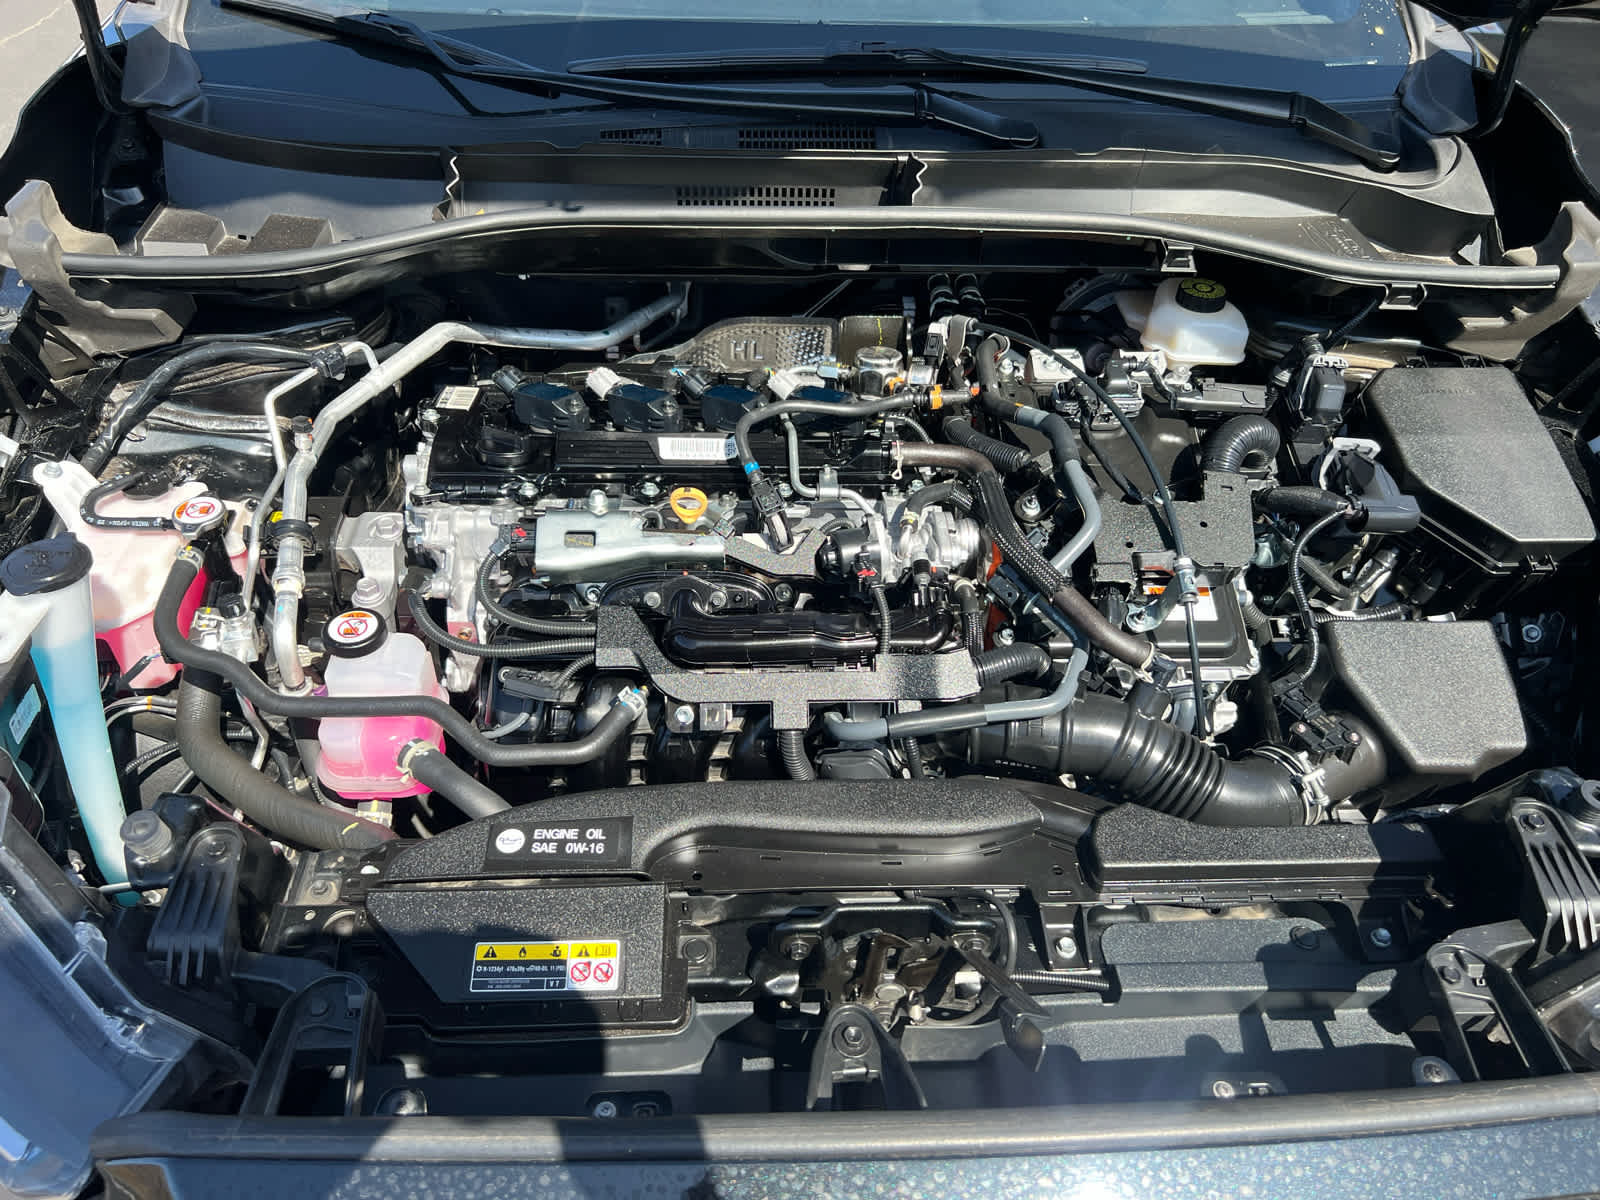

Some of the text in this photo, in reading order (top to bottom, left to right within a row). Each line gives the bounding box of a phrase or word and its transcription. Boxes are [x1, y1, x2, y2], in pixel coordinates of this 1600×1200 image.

[730, 340, 765, 361] HL
[533, 828, 607, 840] ENGINE OIL
[531, 842, 605, 854] SAE 0W-16
